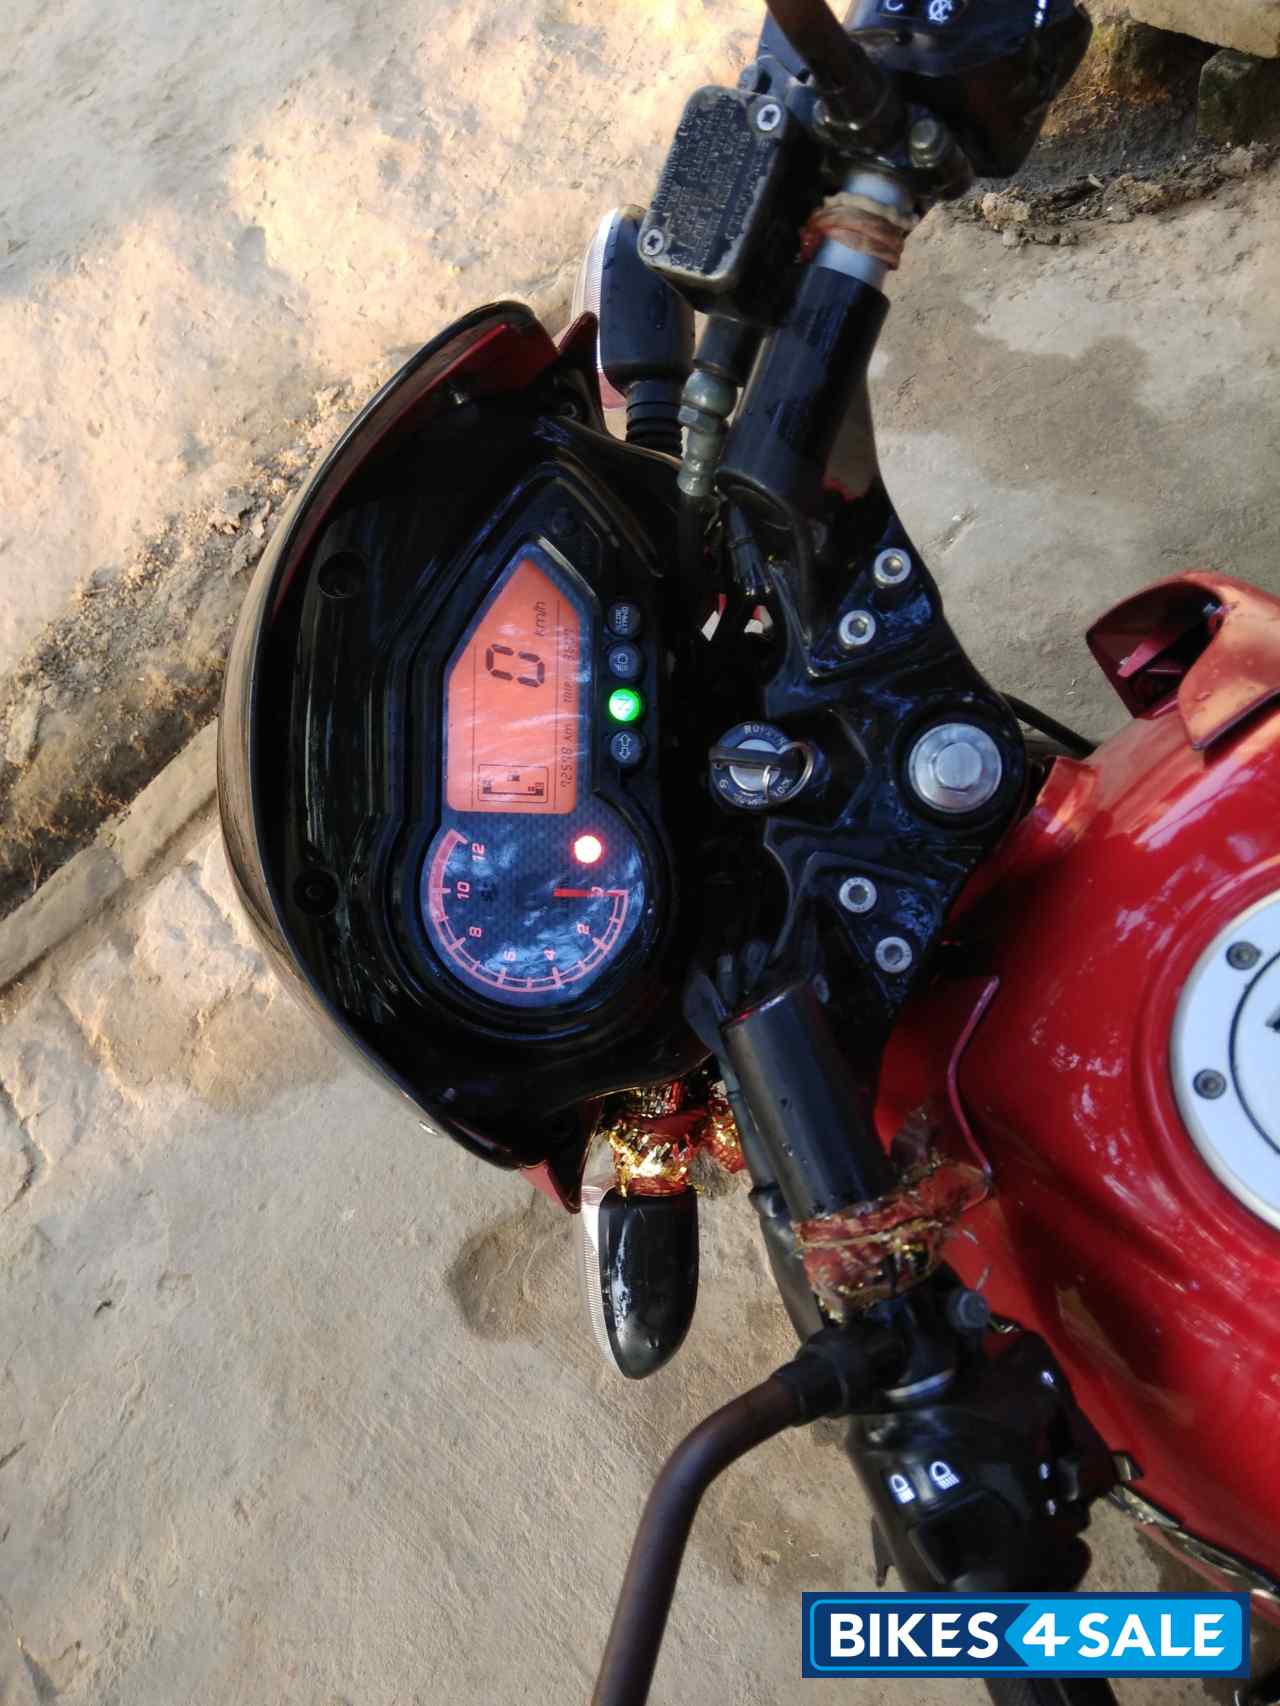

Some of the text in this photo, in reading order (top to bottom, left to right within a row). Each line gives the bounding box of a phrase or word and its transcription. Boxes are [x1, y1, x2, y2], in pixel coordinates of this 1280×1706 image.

[486, 643, 545, 688] 0
[472, 842, 485, 861] 12
[457, 881, 470, 899] 10
[469, 926, 482, 938] 8
[577, 923, 590, 935] 2
[544, 949, 556, 961] 4
